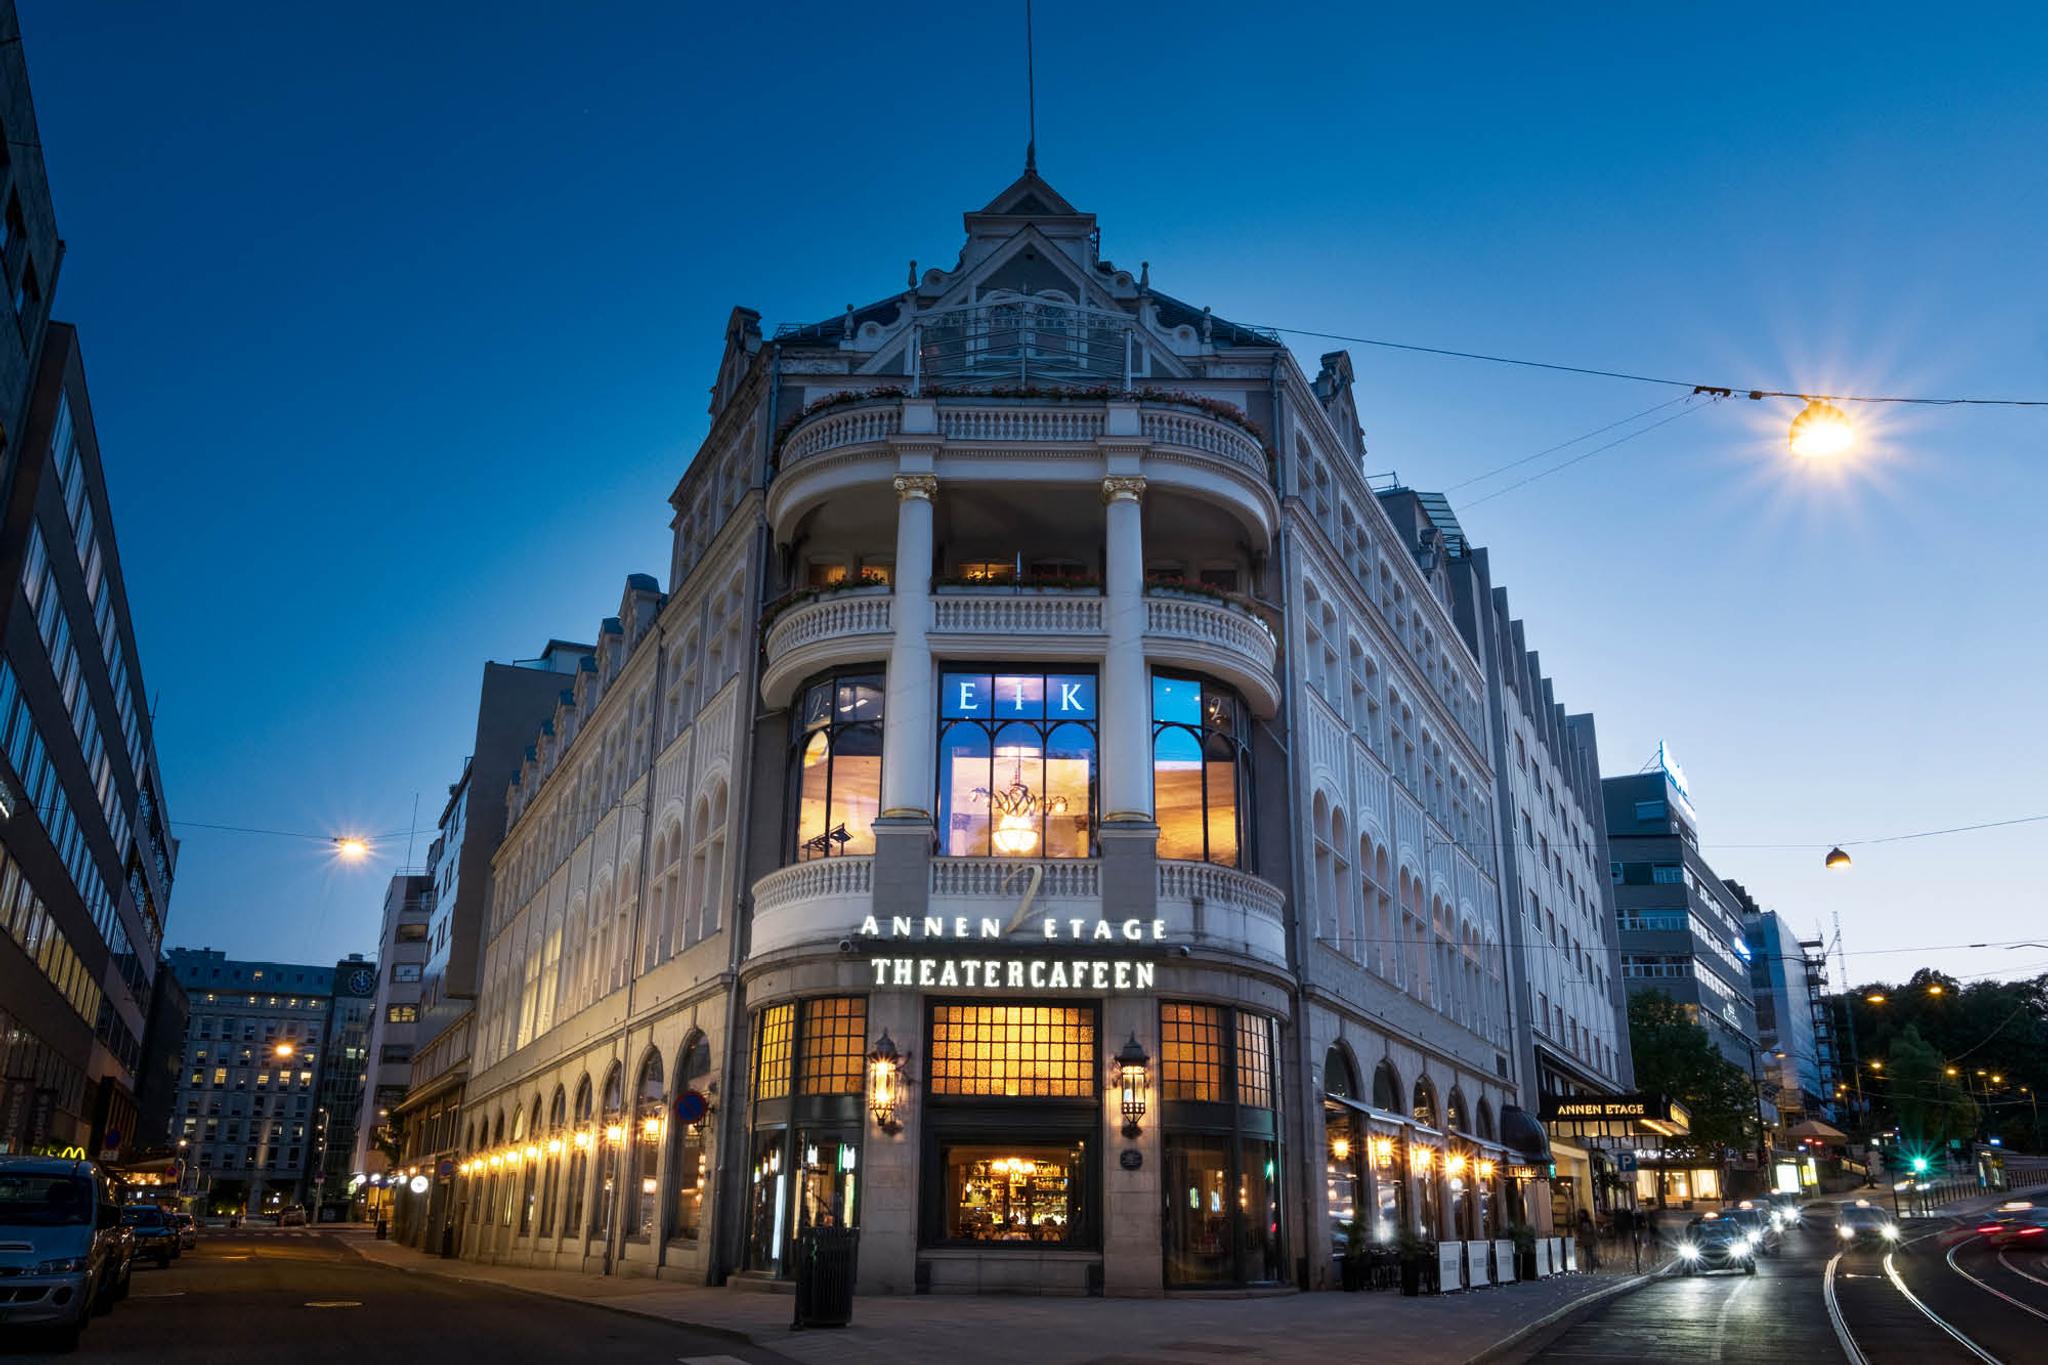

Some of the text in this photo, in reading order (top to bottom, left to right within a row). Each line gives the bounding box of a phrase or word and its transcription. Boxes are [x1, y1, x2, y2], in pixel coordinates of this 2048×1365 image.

[861, 915, 1166, 940] ANNEN ETAGE
[871, 957, 1155, 990] THEATERCAFEEN
[1558, 1104, 1645, 1115] ANNEN ETAGE
[1621, 1157, 1632, 1170] P
